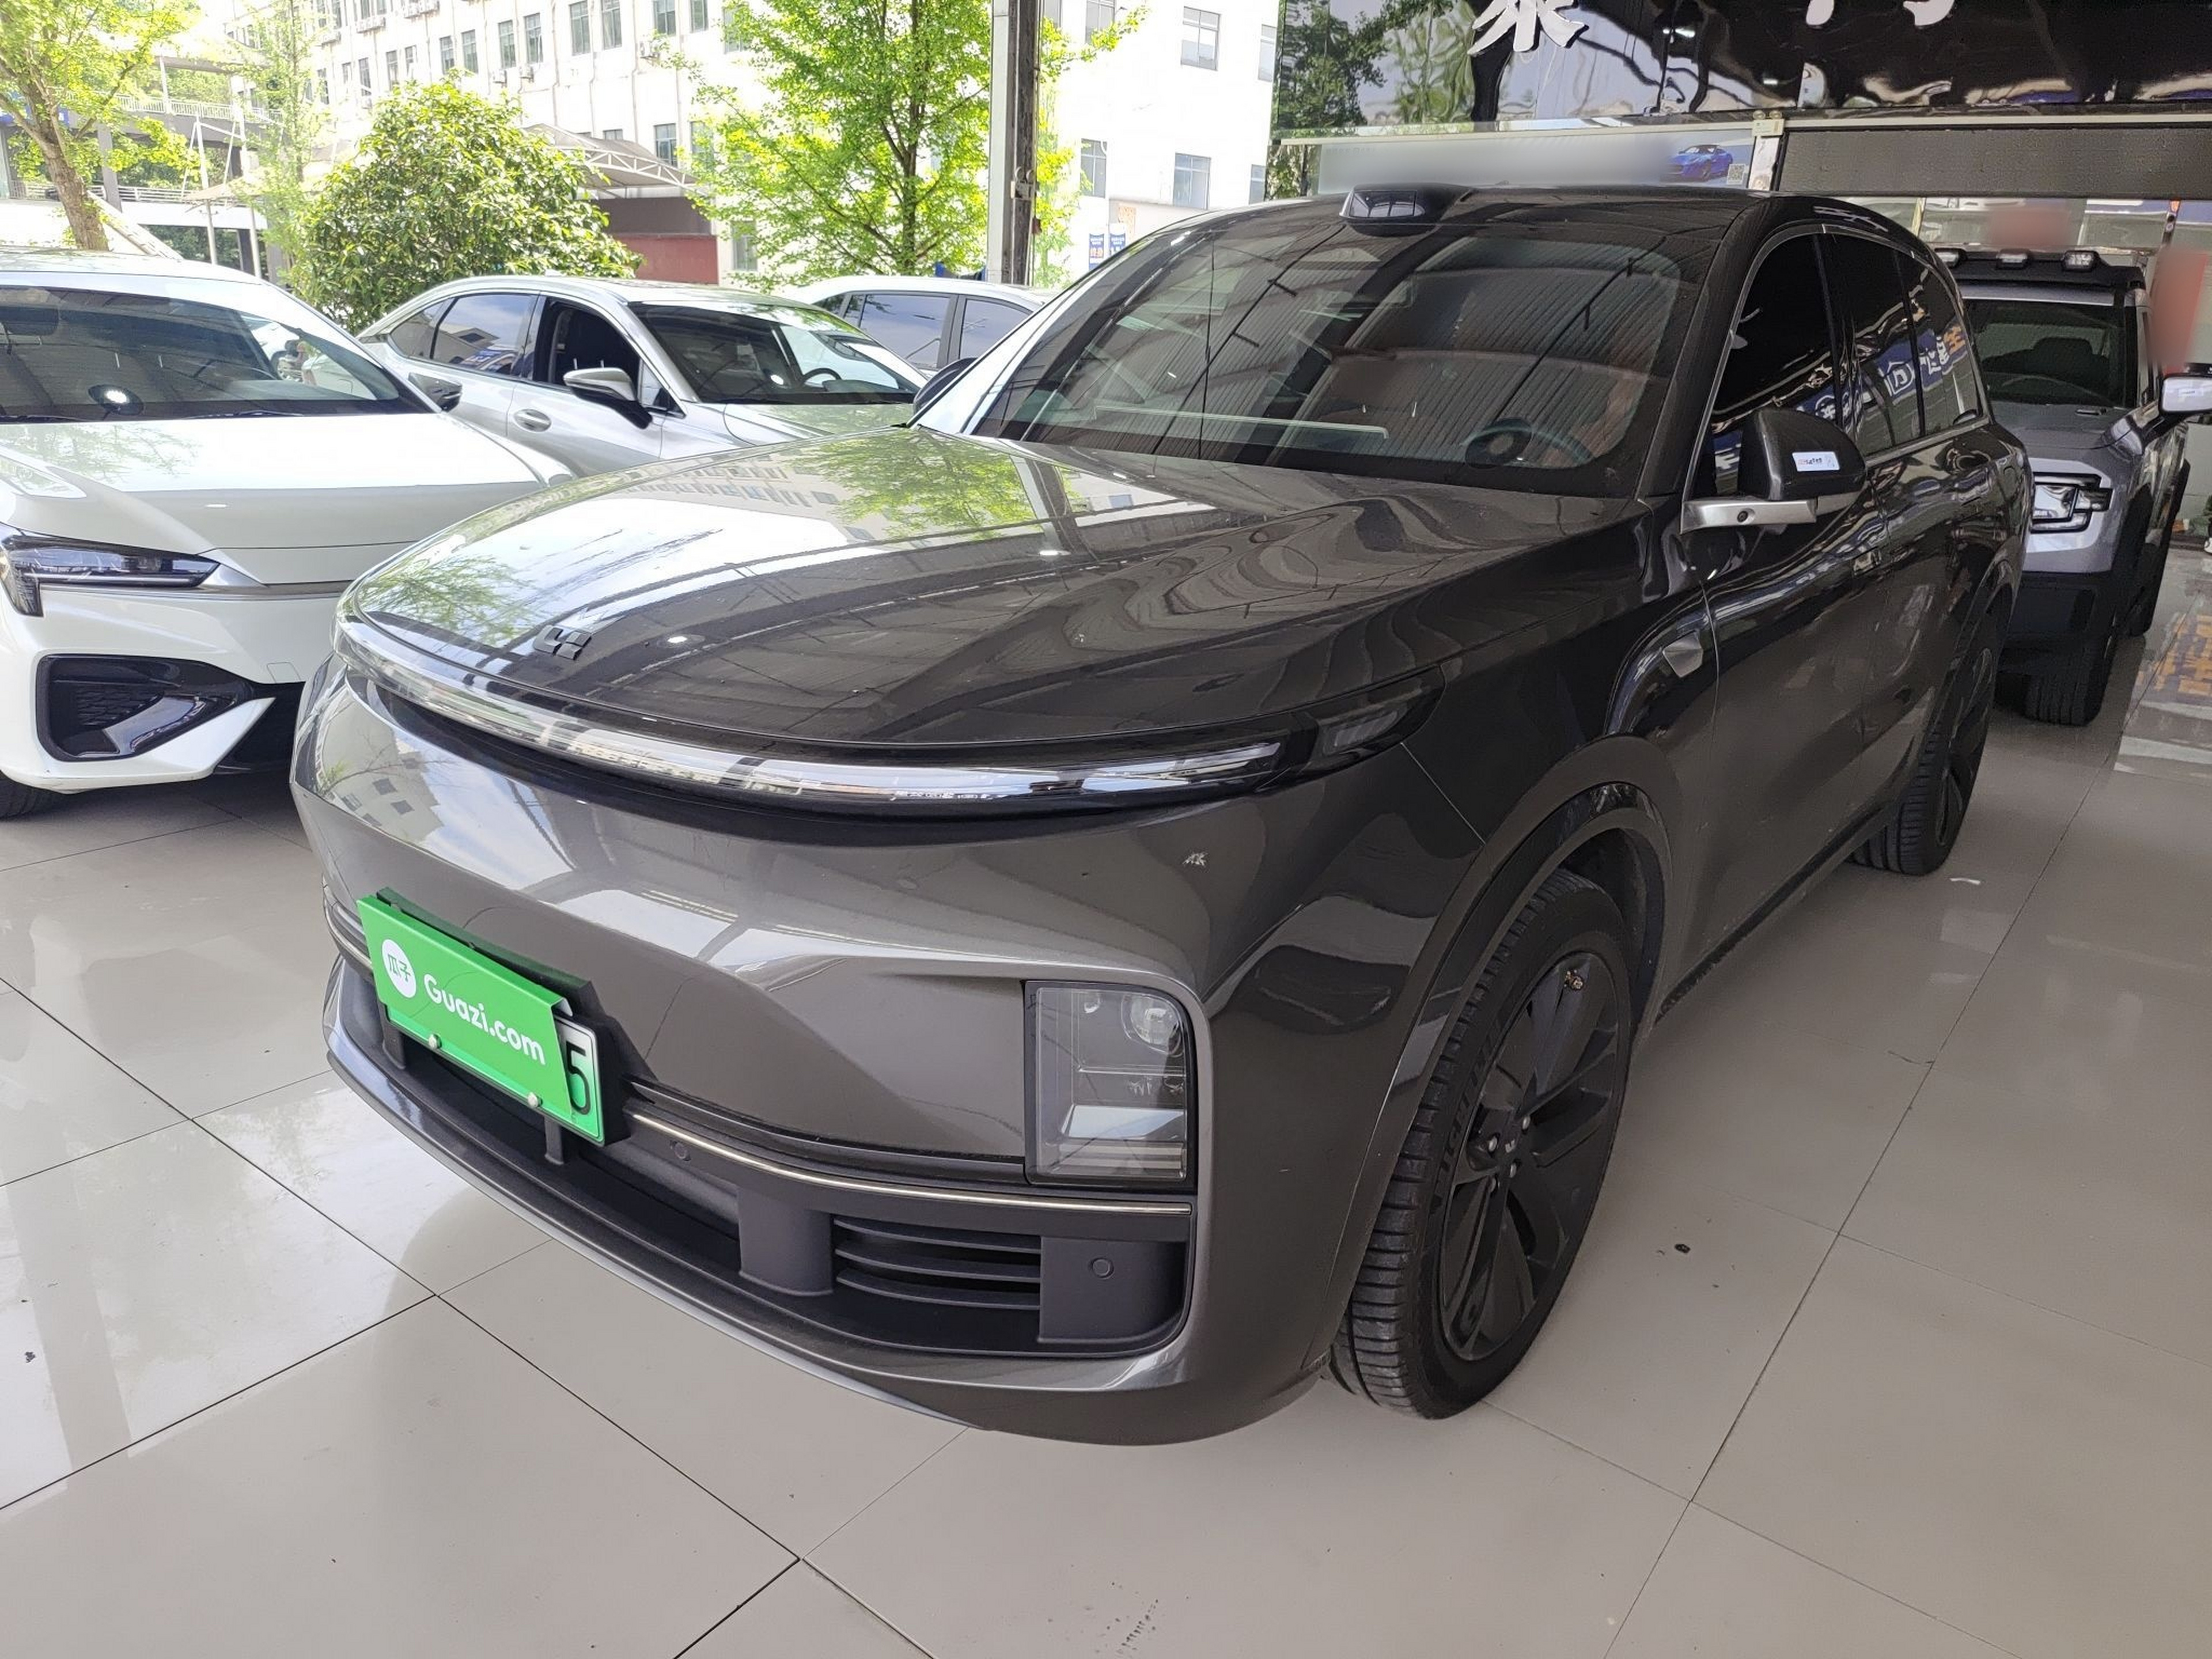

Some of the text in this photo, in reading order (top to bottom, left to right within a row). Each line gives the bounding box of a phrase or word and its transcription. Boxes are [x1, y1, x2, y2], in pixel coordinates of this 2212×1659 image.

[387, 952, 411, 983] 瓜子
[424, 974, 546, 1065] Guazi.com
[566, 1040, 591, 1115] 5
